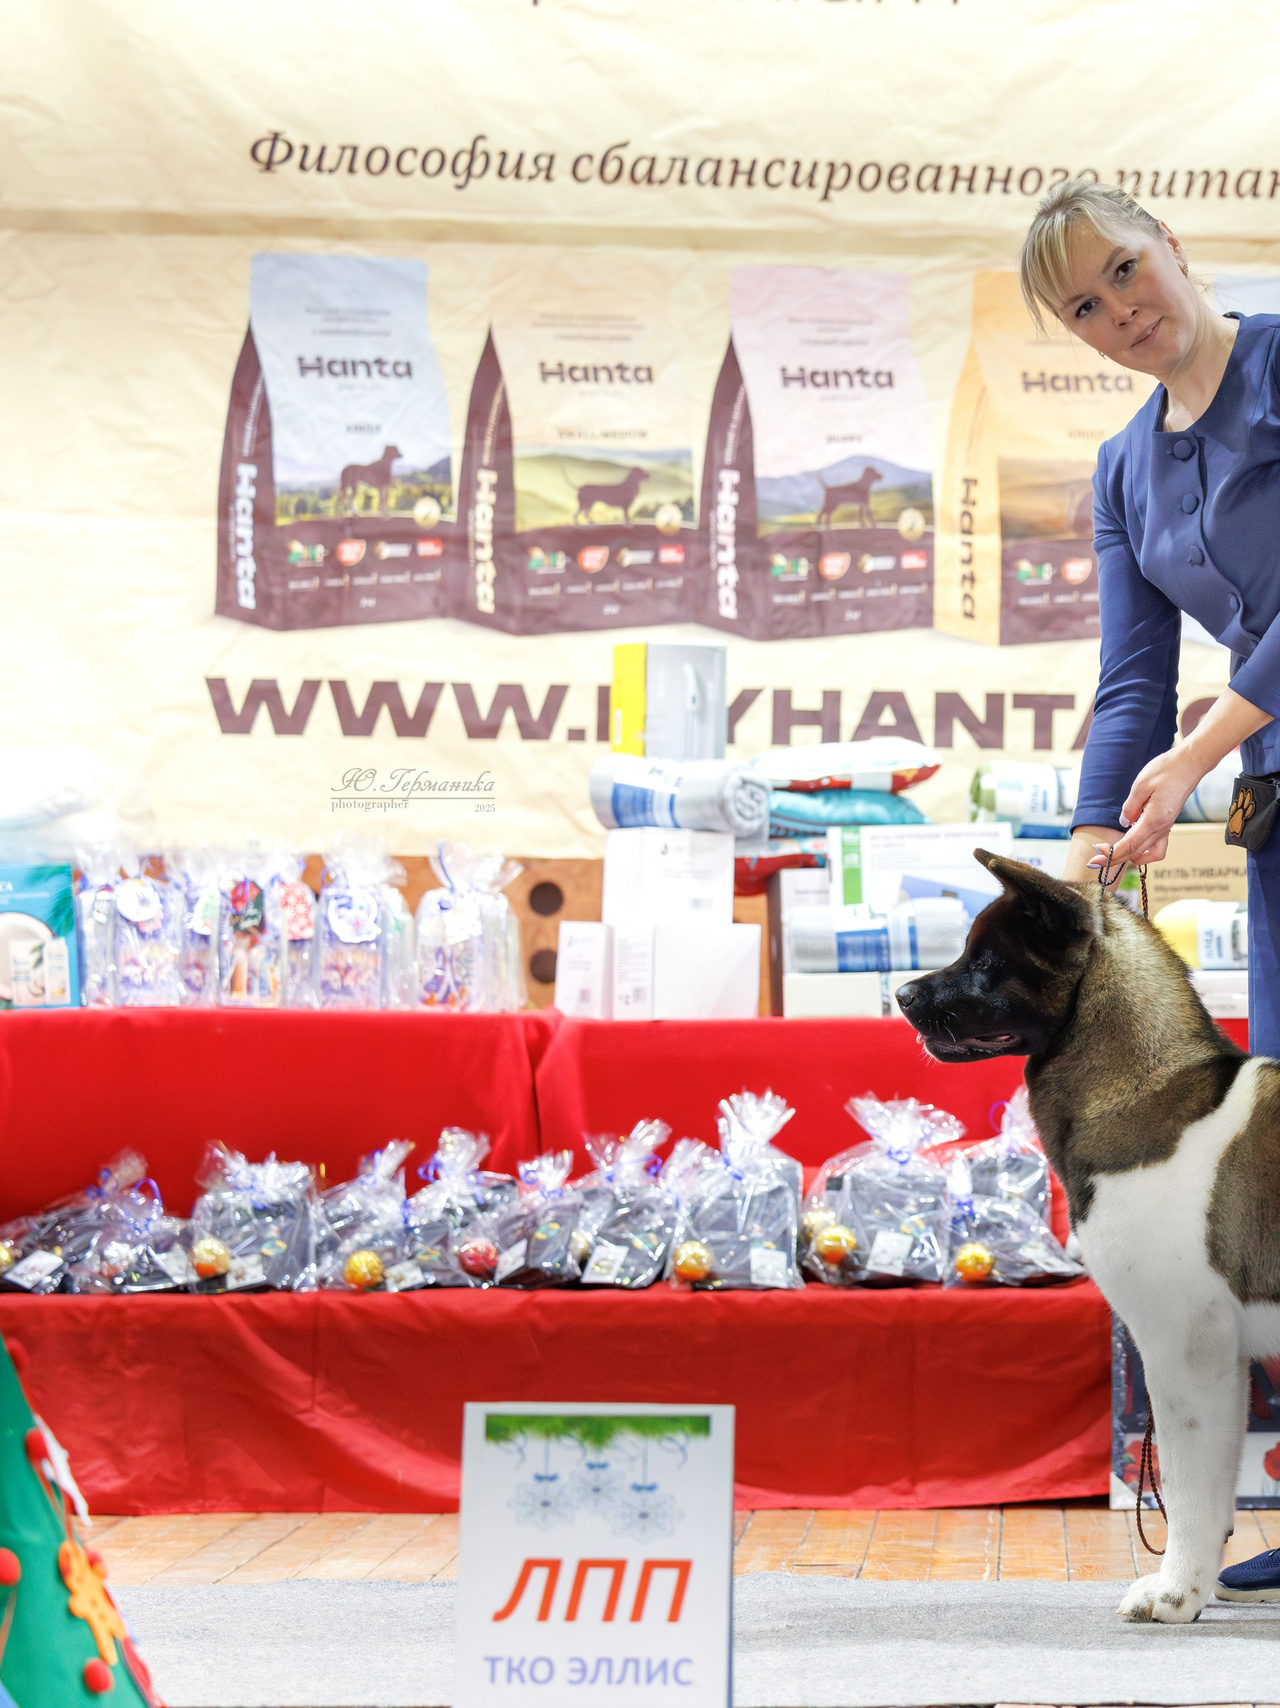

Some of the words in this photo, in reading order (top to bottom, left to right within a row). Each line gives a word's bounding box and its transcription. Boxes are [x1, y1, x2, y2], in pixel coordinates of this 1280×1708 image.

[249, 131, 558, 190] Философия
[297, 355, 414, 379] Hanta
[538, 360, 655, 385] Hanta
[780, 365, 895, 390] Hanta
[1021, 370, 1134, 394] Hanta
[234, 462, 258, 610] Hanta
[474, 468, 499, 615] Hanta
[715, 468, 741, 620] Hanta
[960, 477, 979, 621] Hanta
[492, 1558, 693, 1622] ЛПП
[483, 1656, 555, 1685] ТКО
[567, 1656, 694, 1685] ЭЛЛИС
